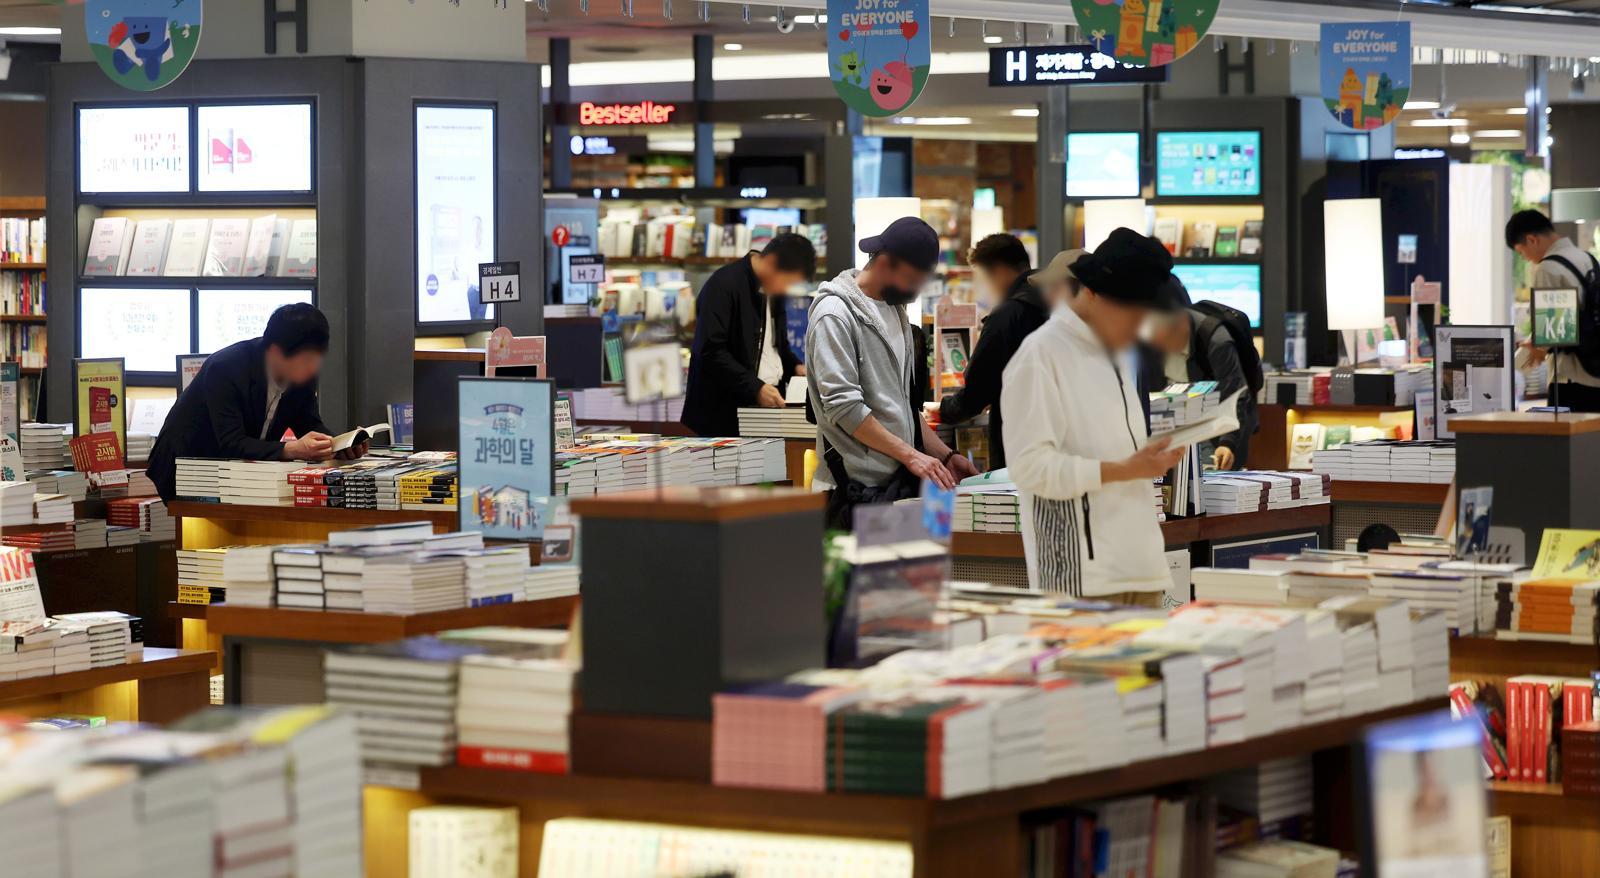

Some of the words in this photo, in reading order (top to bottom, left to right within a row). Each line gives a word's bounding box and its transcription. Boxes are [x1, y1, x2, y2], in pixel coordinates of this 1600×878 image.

[856, 0, 881, 10] JOY
[883, 0, 898, 8] for
[841, 10, 914, 26] EVERYONE
[1345, 29, 1369, 40] JOY
[1370, 31, 1384, 40] for
[1333, 41, 1398, 54] EVERYONE
[1006, 50, 1027, 82] H
[580, 100, 675, 125] Bestseller
[483, 266, 502, 275] 경제일반
[577, 269, 586, 280] H
[590, 268, 596, 280] 7
[490, 281, 499, 299] H
[504, 280, 513, 298] 4
[1545, 315, 1566, 340] K4
[96, 446, 116, 456] 고시원
[474, 437, 516, 464] 과학의
[520, 438, 534, 465] 달
